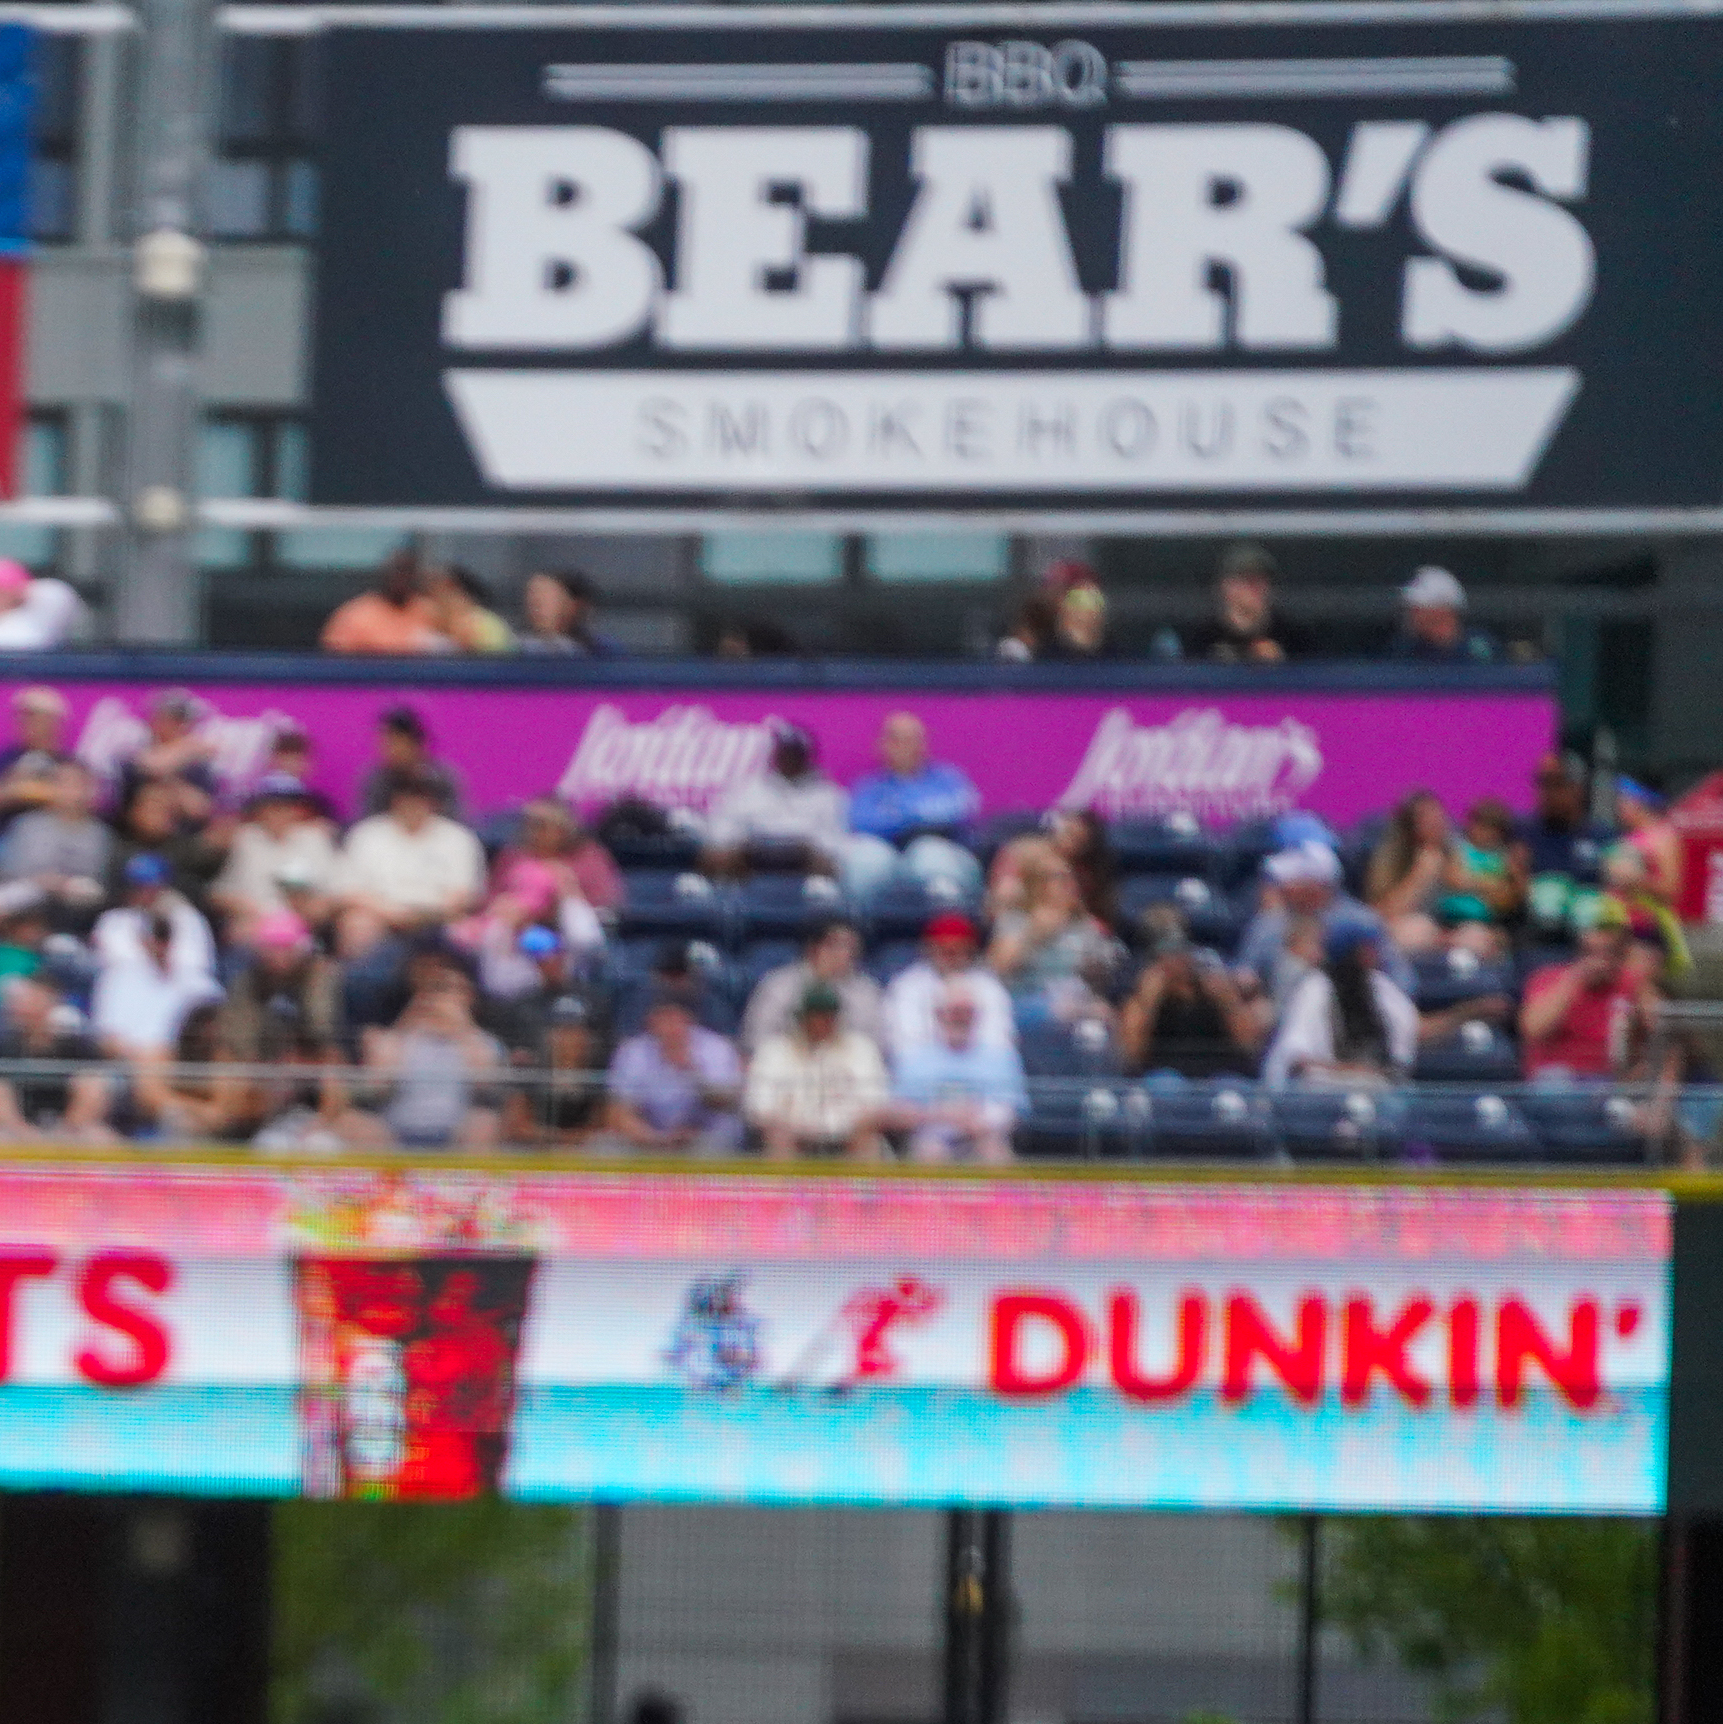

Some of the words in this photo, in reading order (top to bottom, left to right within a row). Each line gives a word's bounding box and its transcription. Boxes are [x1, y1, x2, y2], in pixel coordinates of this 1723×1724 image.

[943, 42, 1111, 108] BBQ
[441, 112, 1599, 353] BEAR'S
[635, 393, 1387, 466] SMOKEHOUSE
[987, 1285, 1645, 1411] DUNKIN'
